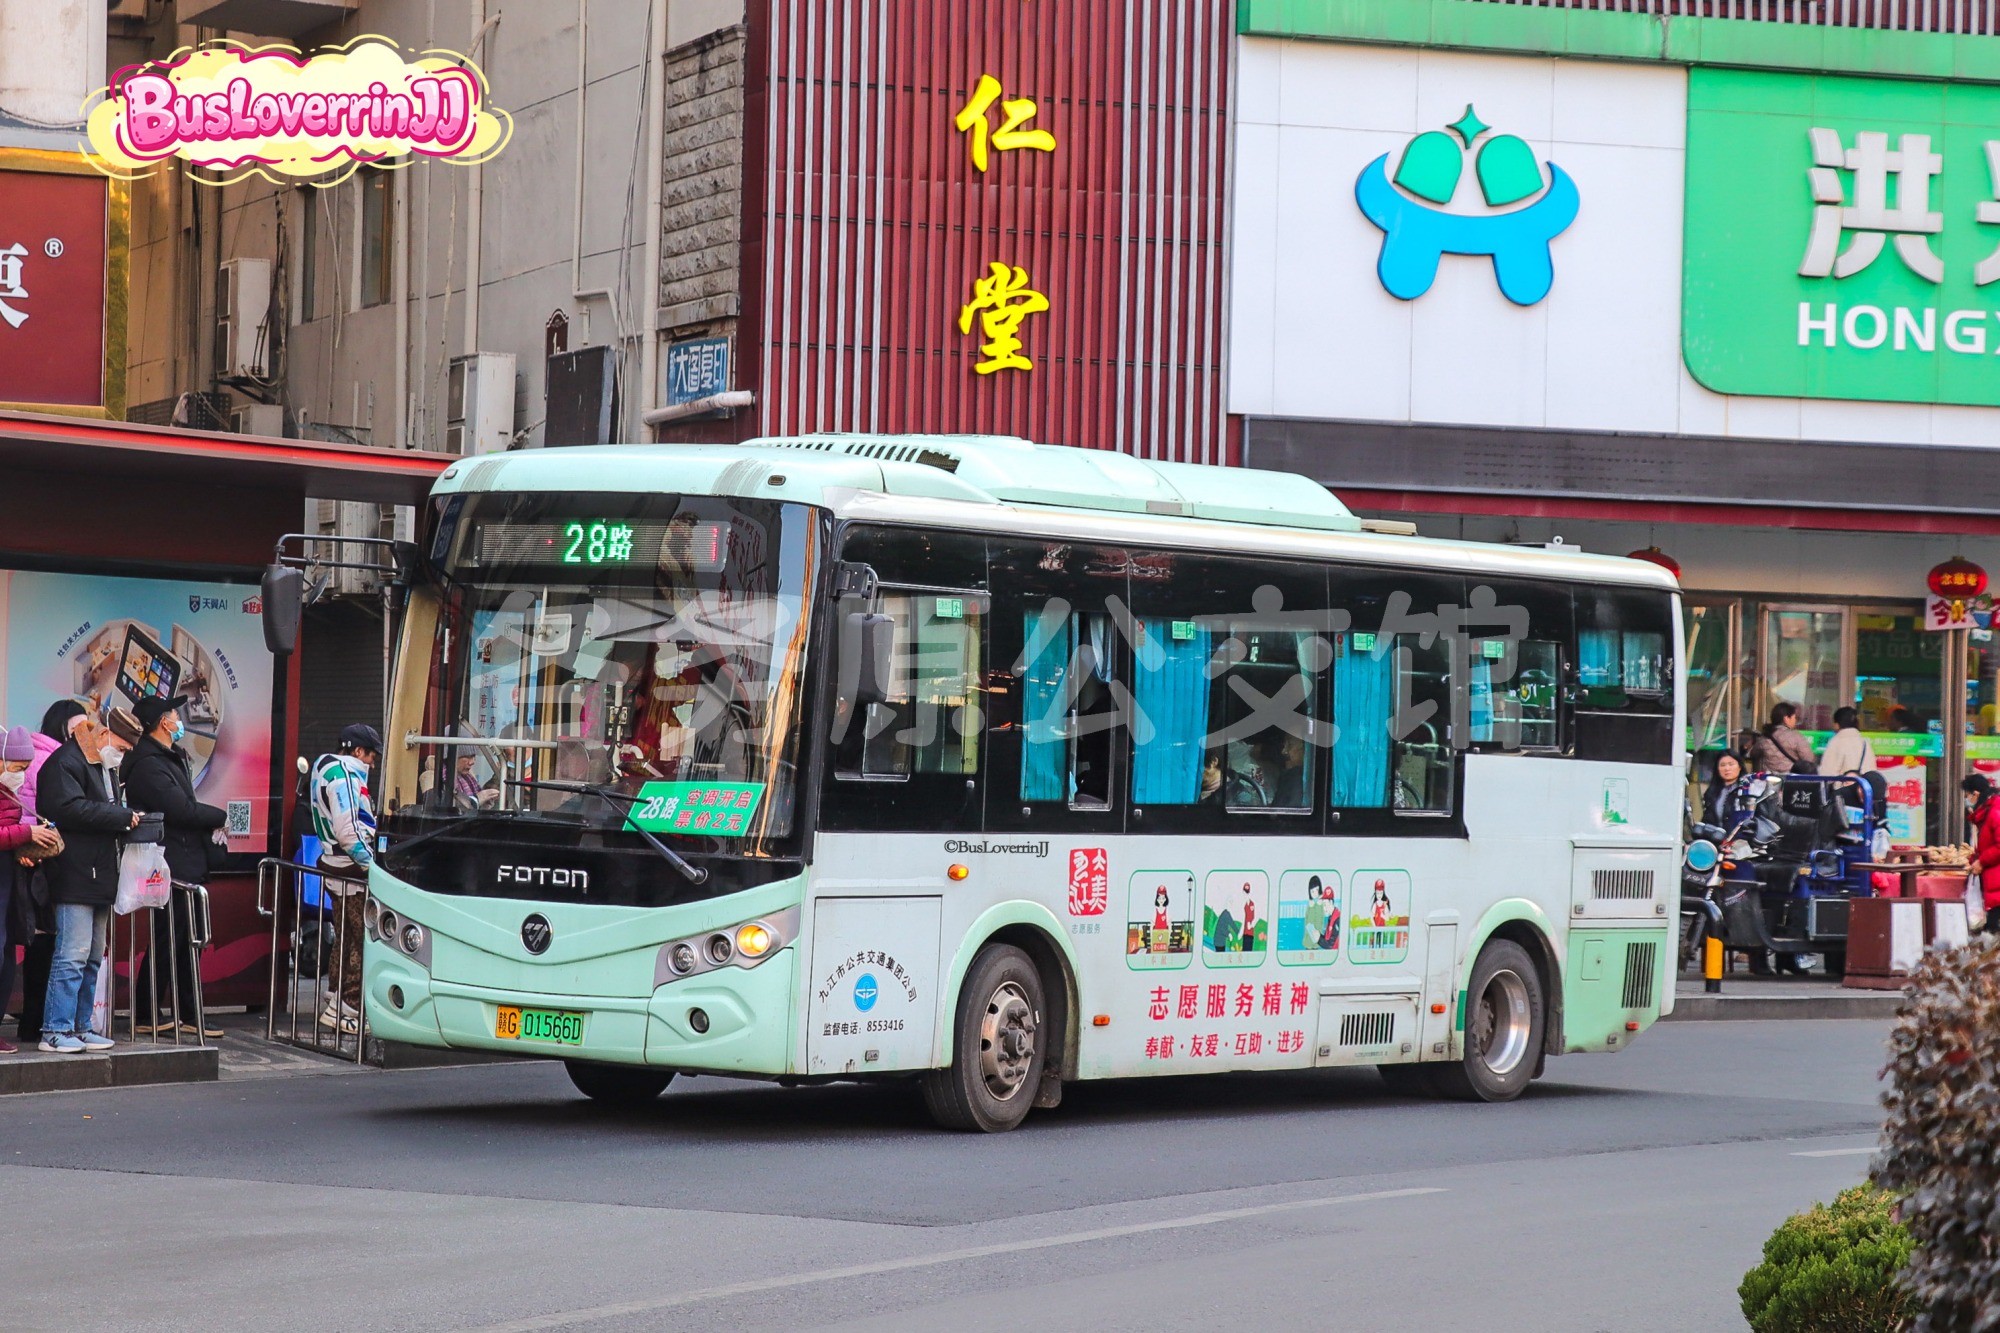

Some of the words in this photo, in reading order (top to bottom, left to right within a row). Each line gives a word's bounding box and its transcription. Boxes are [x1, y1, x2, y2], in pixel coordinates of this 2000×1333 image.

[1797, 127, 2000, 287] 洪
[1797, 302, 2000, 355] HONG
[564, 523, 633, 563] 28路
[637, 796, 680, 819] 28路
[685, 789, 752, 808] 空调开启
[674, 810, 743, 831] 票价2元
[497, 865, 587, 888] FOTON
[1071, 923, 1102, 934] 志愿服务
[819, 949, 918, 1003] 九江市公共交通集团公司
[1148, 982, 1309, 1021] 志愿服务精神
[866, 1019, 904, 1032] 8553416
